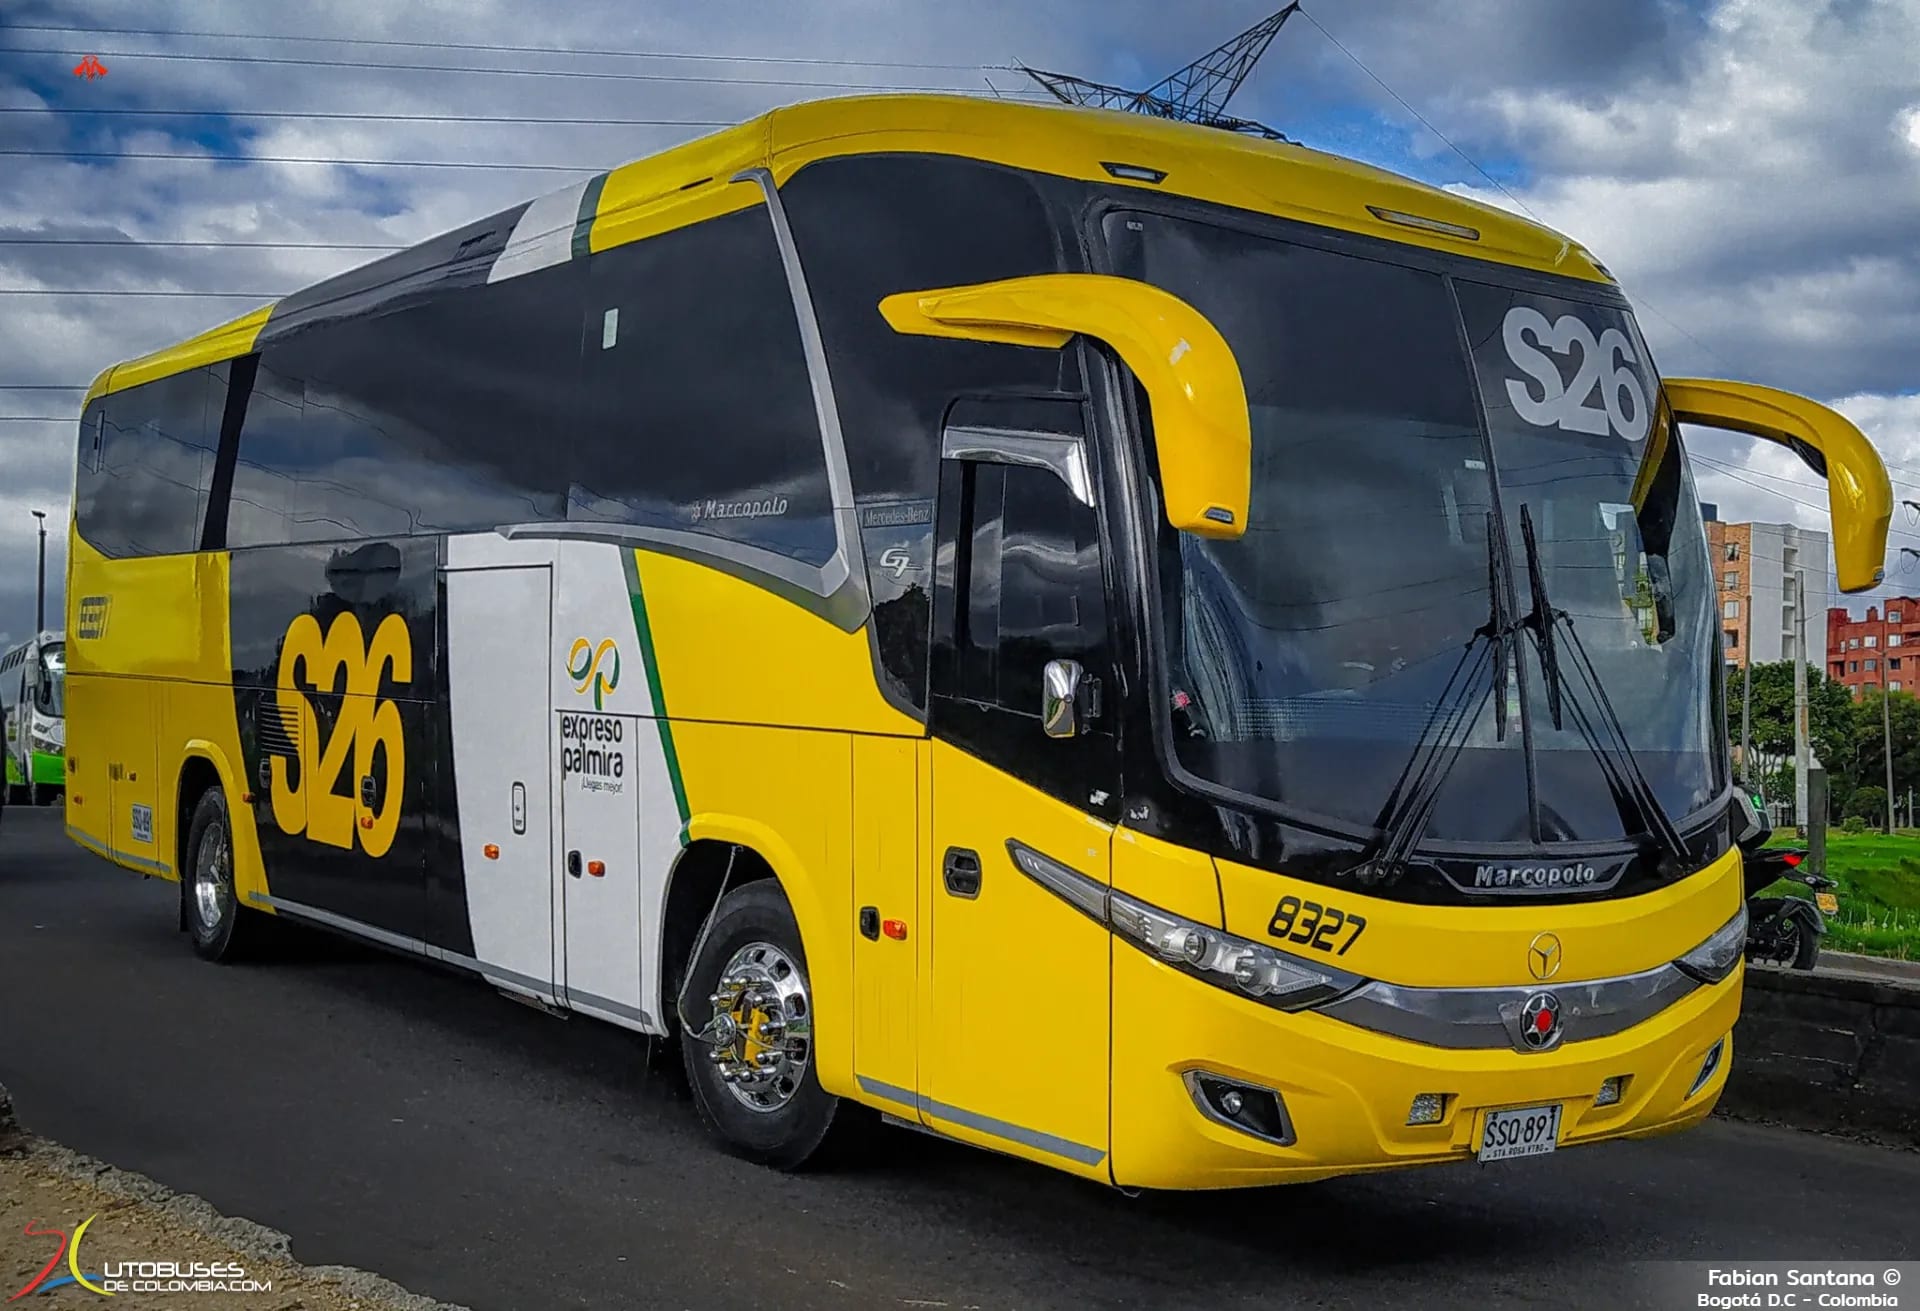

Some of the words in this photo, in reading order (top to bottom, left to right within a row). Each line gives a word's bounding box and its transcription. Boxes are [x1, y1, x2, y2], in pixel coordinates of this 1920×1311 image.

[1502, 307, 1648, 441] S26
[704, 497, 788, 519] Marcopolo
[270, 611, 412, 858] S26
[562, 715, 622, 748] expreso
[562, 743, 624, 780] palmira
[1474, 864, 1595, 888] Marcopolo
[1267, 895, 1367, 956] 8327
